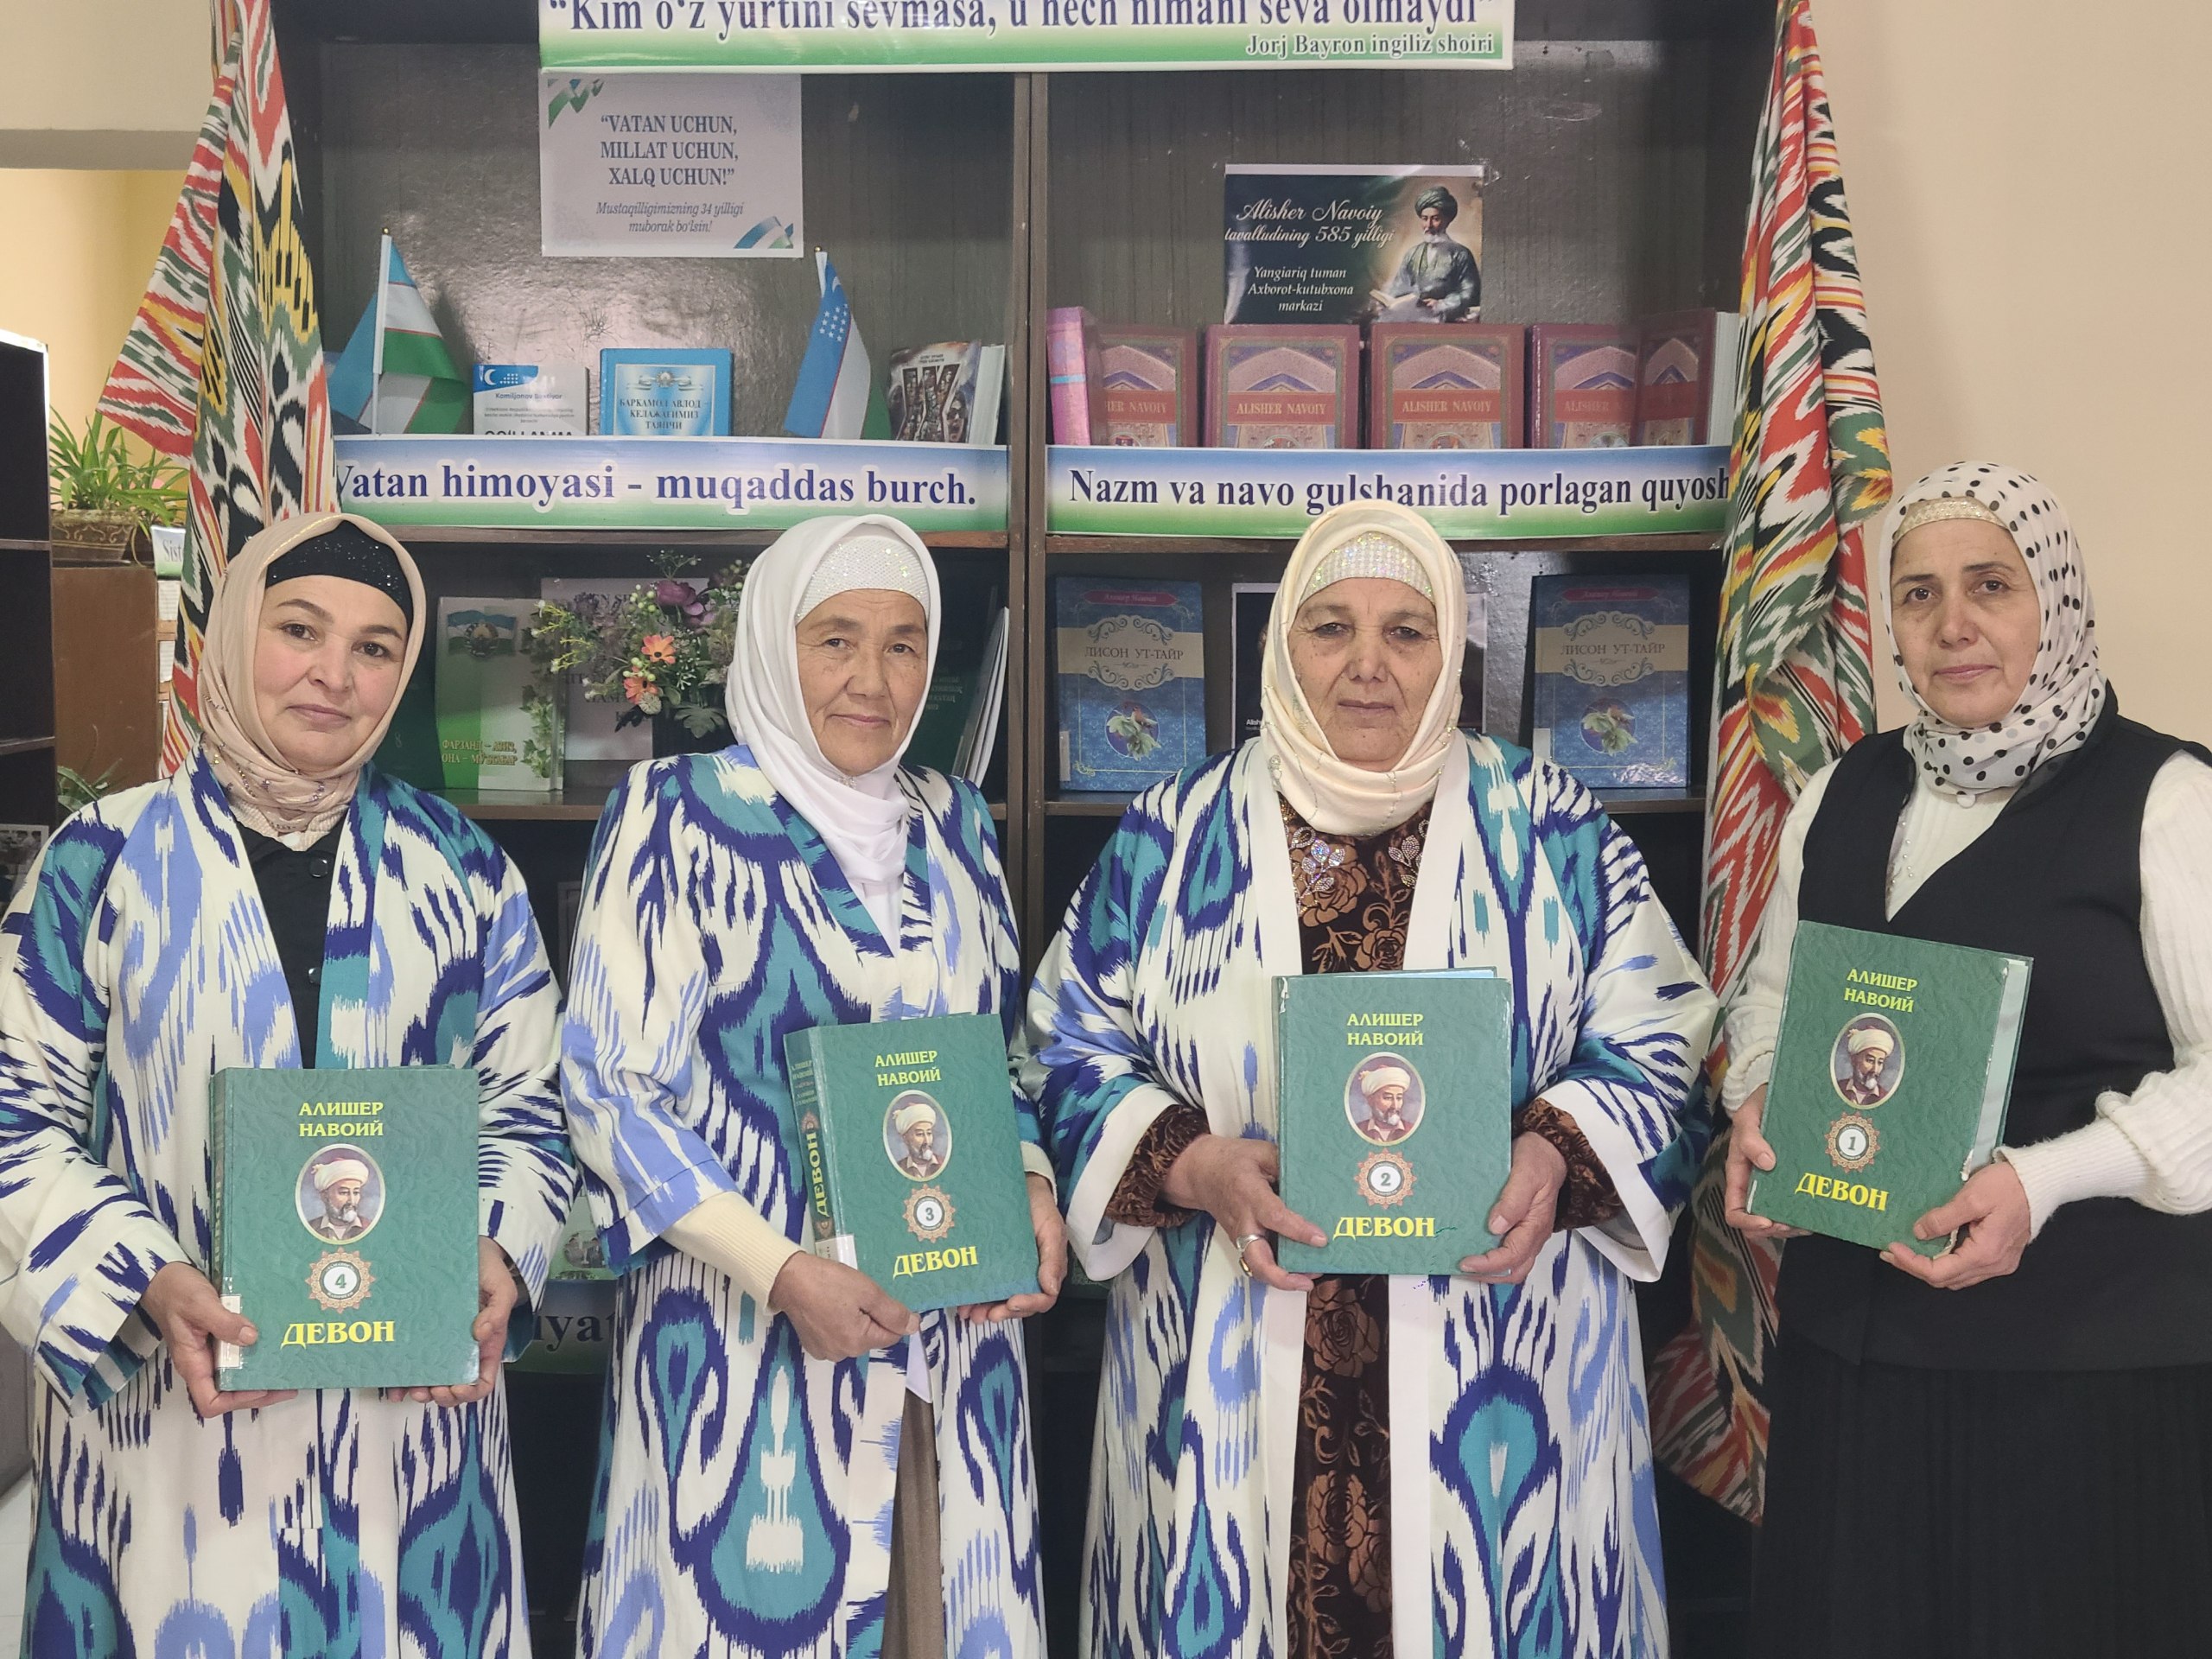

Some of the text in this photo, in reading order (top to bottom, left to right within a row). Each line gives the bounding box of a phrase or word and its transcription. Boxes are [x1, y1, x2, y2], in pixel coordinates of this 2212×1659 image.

[717, 0, 834, 41] yurtini
[848, 0, 996, 36] sevmasa,
[1010, 0, 1028, 26] u
[1260, 0, 1329, 24] seva
[1248, 34, 1493, 57] Jorj Bayron ingiliz shoiri
[601, 115, 737, 136] “VATAN UCHUN,
[601, 141, 738, 161] MILLAT UCHUN,
[609, 168, 734, 187] XALQ UCHUN!”
[596, 202, 744, 217] Mustaqilligimizning 34 yilligi
[1236, 199, 1384, 228] Alisher Navoiy
[629, 219, 674, 232] muborak
[1224, 225, 1395, 249] tavalludining 585 yilligi
[1254, 266, 1347, 282] Yangiariq tuman
[1248, 283, 1354, 296] Axborot-kutubxona
[1278, 299, 1323, 312] markazi
[1129, 401, 1167, 414] NAVOIY
[1236, 403, 1327, 415] ALISHER NAVOIY
[1402, 400, 1491, 412] ALISHER NAVOIY
[442, 464, 616, 506] himoyasi
[657, 467, 854, 510] muqaddas
[866, 469, 976, 505] burch.
[1069, 469, 1158, 503] Nazm
[1169, 481, 1205, 505] va
[1217, 480, 1294, 506] navo
[1306, 474, 1488, 516] gulshanida
[1500, 473, 1631, 516] porlagan
[1084, 646, 1184, 660] ЛИСОН УТ-ТАЙР
[1560, 642, 1666, 656] ЛИСОН УТ-ТАЙР
[442, 753, 461, 763] ОНА
[1847, 968, 1918, 993] АЛИШЕР
[1843, 988, 1915, 1014] НАВОИЙ
[1346, 1013, 1424, 1027] АЛИШЕР
[1347, 1030, 1424, 1046] НАВОИЙ
[874, 1050, 938, 1068] АЛИШЕР
[877, 1066, 942, 1087] НАВОИЙ
[298, 1102, 385, 1116] АЛИШЕР
[298, 1119, 385, 1137] НАВОИЙ
[1847, 1135, 1857, 1151] 1
[804, 1131, 830, 1217] ДЕВОН
[1380, 1172, 1391, 1187] 2
[1794, 1172, 1890, 1211] ДЕВОН
[925, 1206, 936, 1221] 3
[1332, 1217, 1436, 1242] ДЕВОН
[892, 1245, 979, 1280] ДЕВОН
[334, 1273, 347, 1288] 4
[280, 1320, 395, 1350] ДЕВОН
